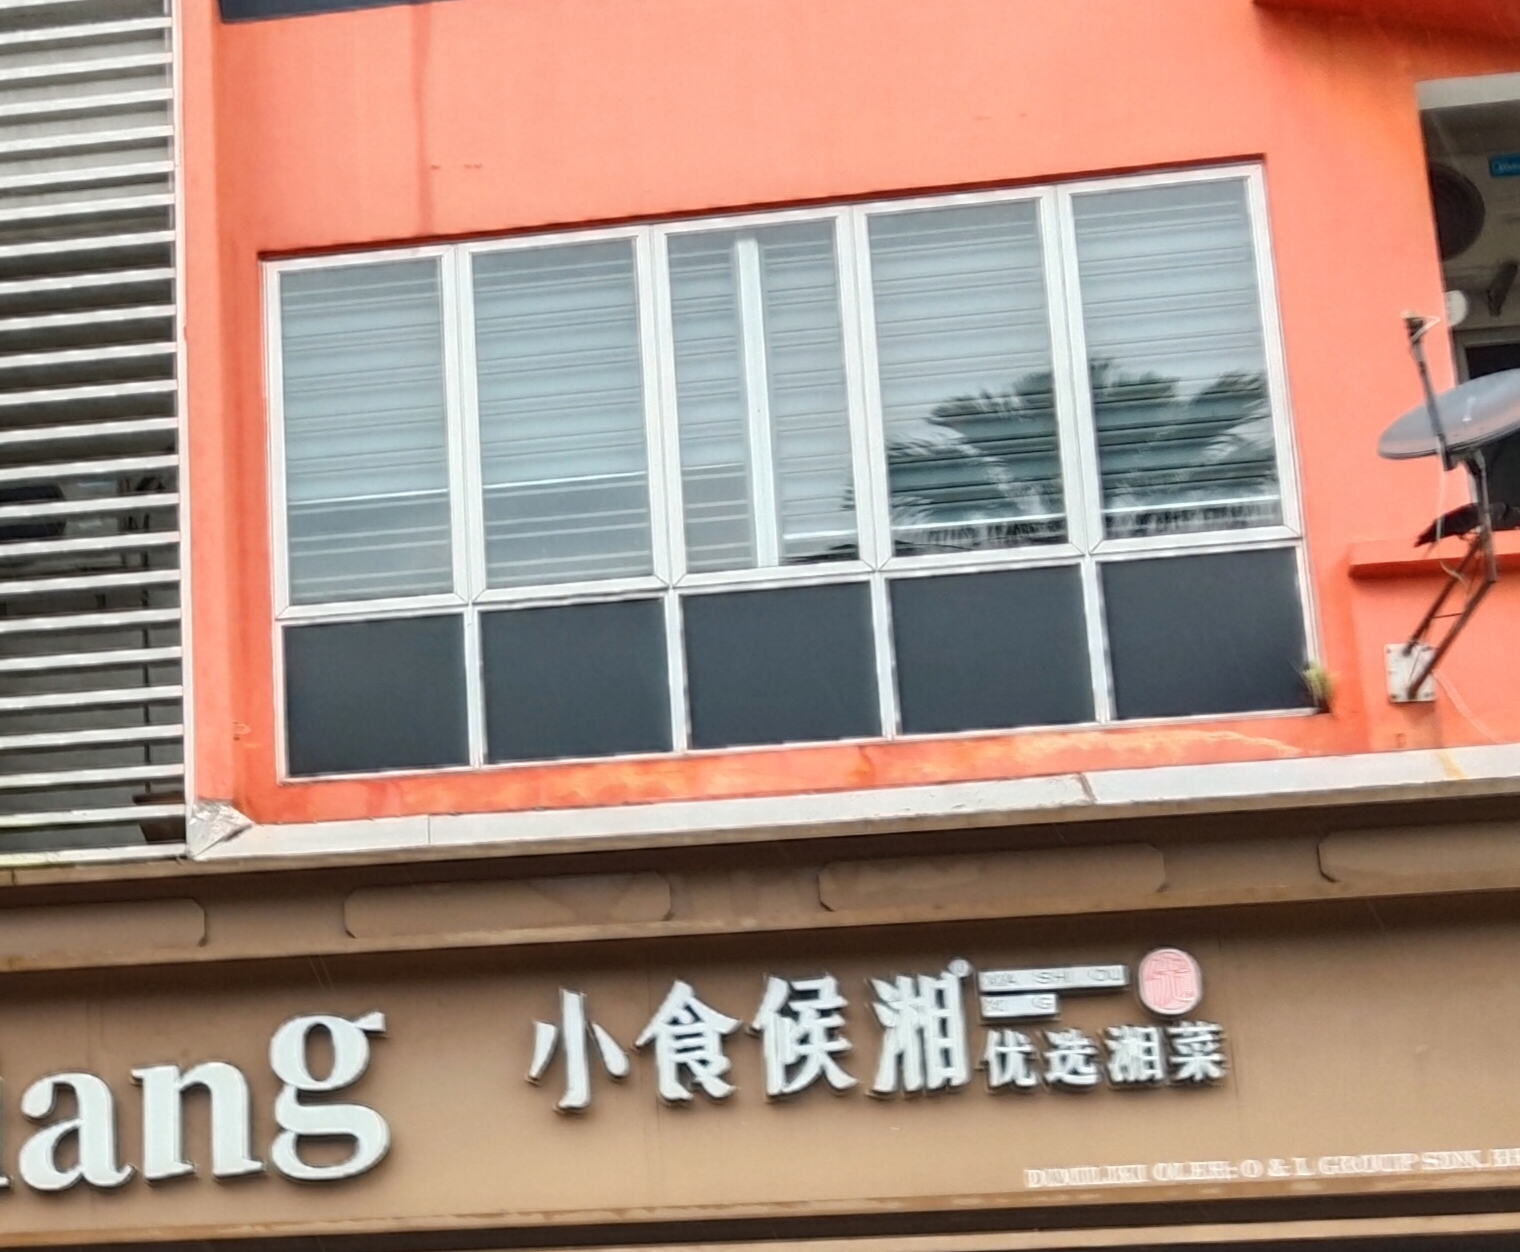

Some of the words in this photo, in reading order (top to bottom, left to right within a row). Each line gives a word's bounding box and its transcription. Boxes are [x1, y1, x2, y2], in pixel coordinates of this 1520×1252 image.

[526, 970, 973, 1111] 小食候湘
[983, 1020, 1228, 1087] 优选湘菜
[1266, 1157, 1291, 1177] &
[1318, 1152, 1419, 1175] GROUP
